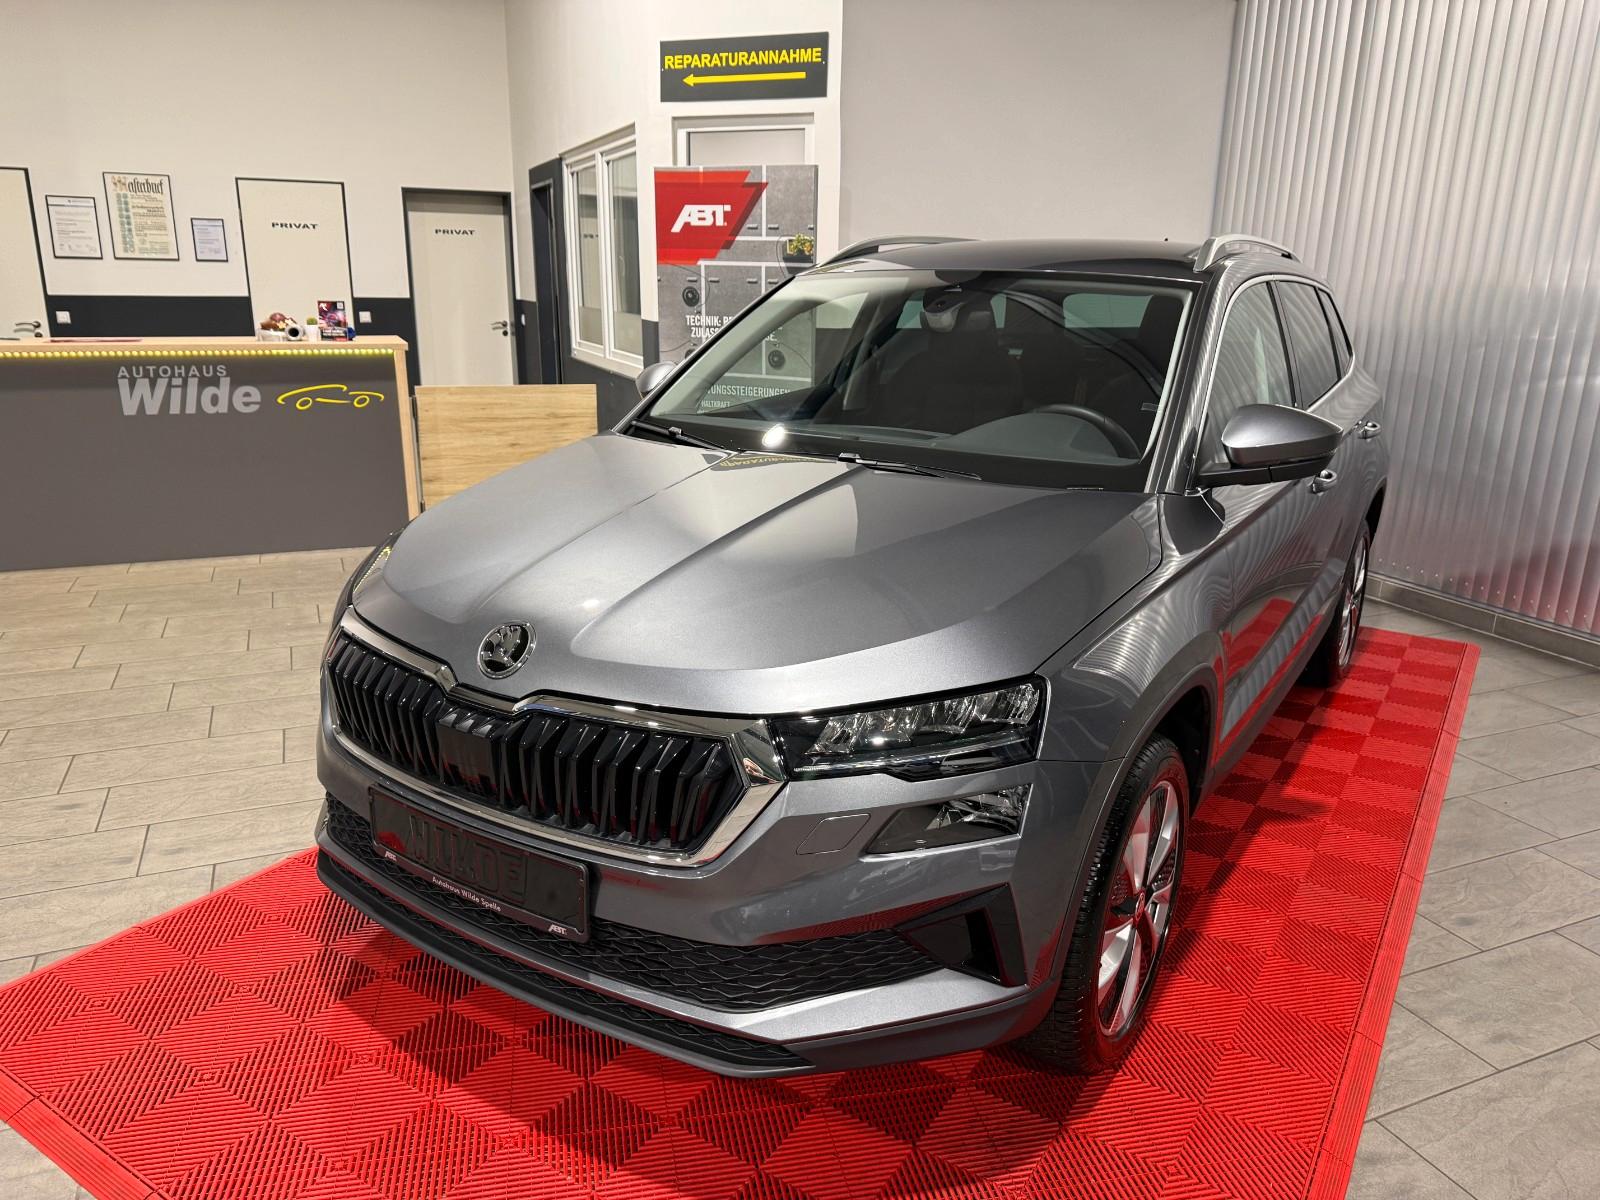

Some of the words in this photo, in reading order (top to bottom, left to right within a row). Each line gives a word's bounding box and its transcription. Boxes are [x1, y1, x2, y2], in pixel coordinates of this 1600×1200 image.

[663, 47, 822, 70] REPARATURANNAHME
[671, 204, 731, 232] ABT
[271, 222, 319, 230] PRIVAT
[434, 228, 476, 236] PRIVAT
[117, 364, 227, 378] AUTOHAUS
[117, 376, 262, 416] Wilde
[548, 924, 566, 935] ABT
